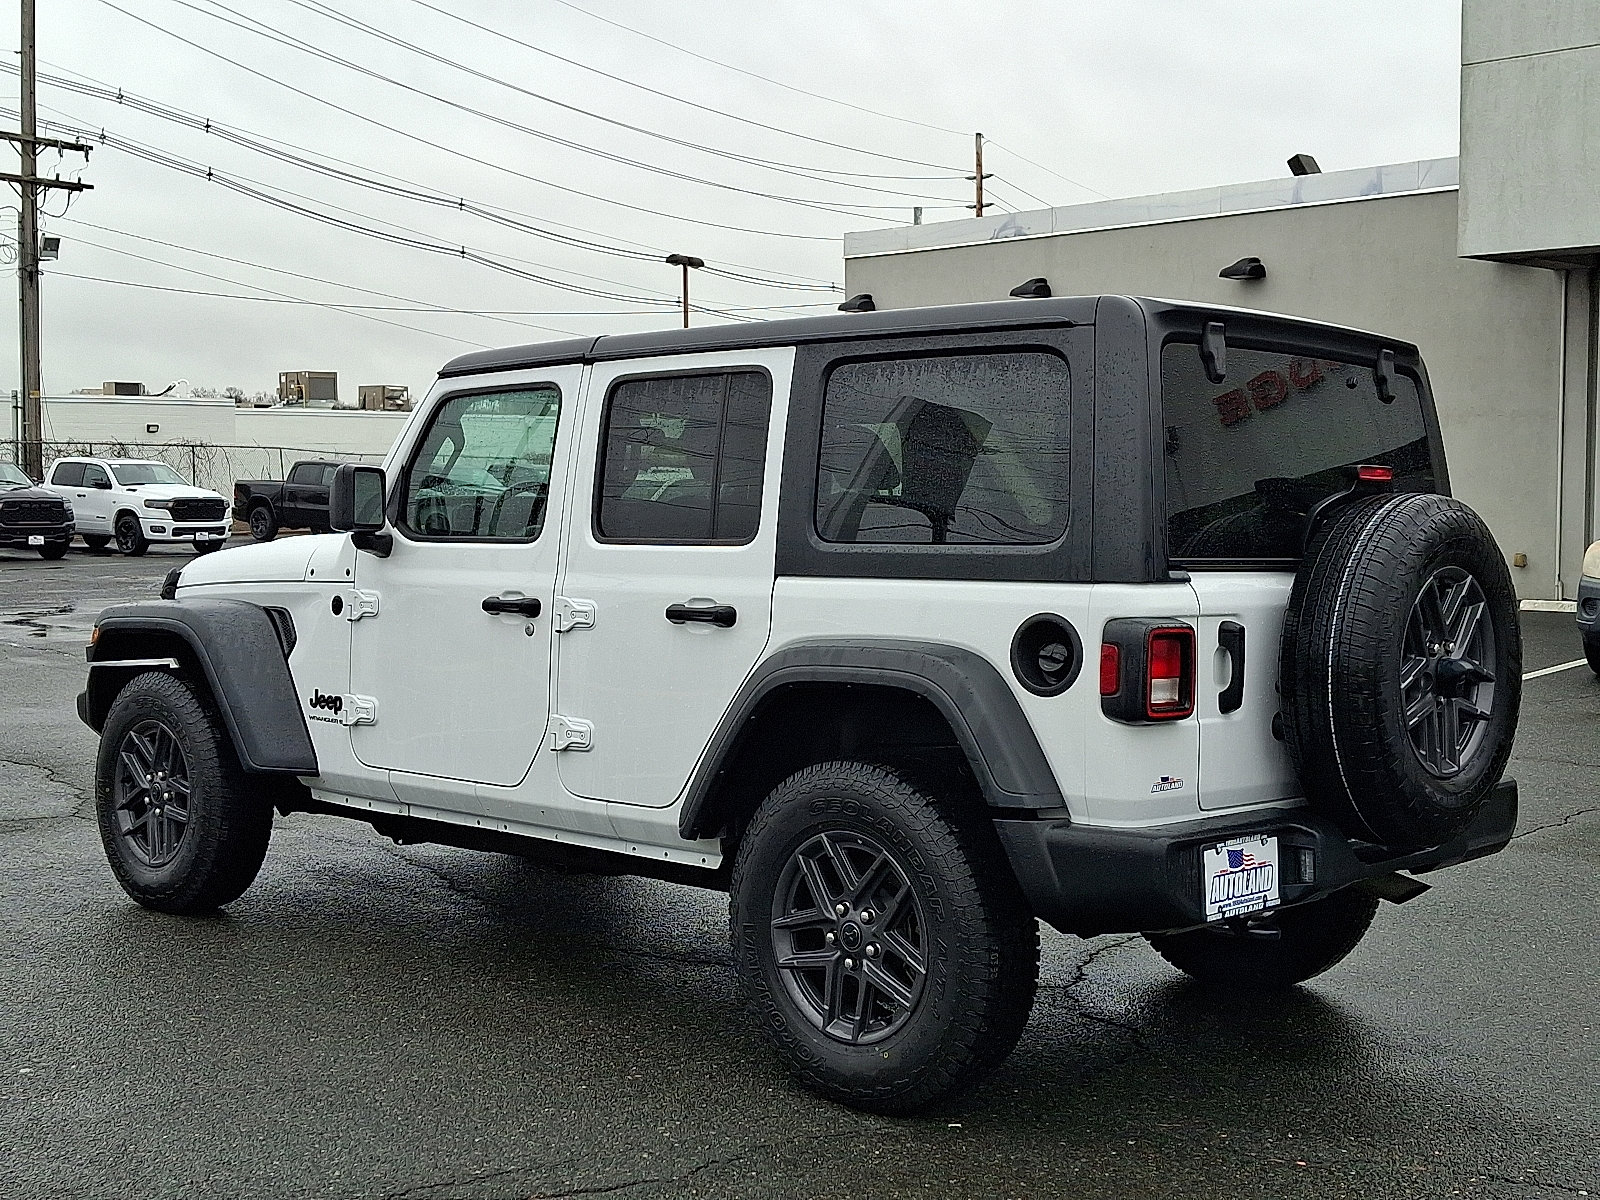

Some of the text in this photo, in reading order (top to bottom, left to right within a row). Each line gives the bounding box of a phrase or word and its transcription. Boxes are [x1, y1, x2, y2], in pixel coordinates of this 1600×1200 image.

[309, 688, 343, 715] Jeep
[1210, 864, 1274, 905] AUTOLAND
[1224, 902, 1265, 918] AUTOLAND
